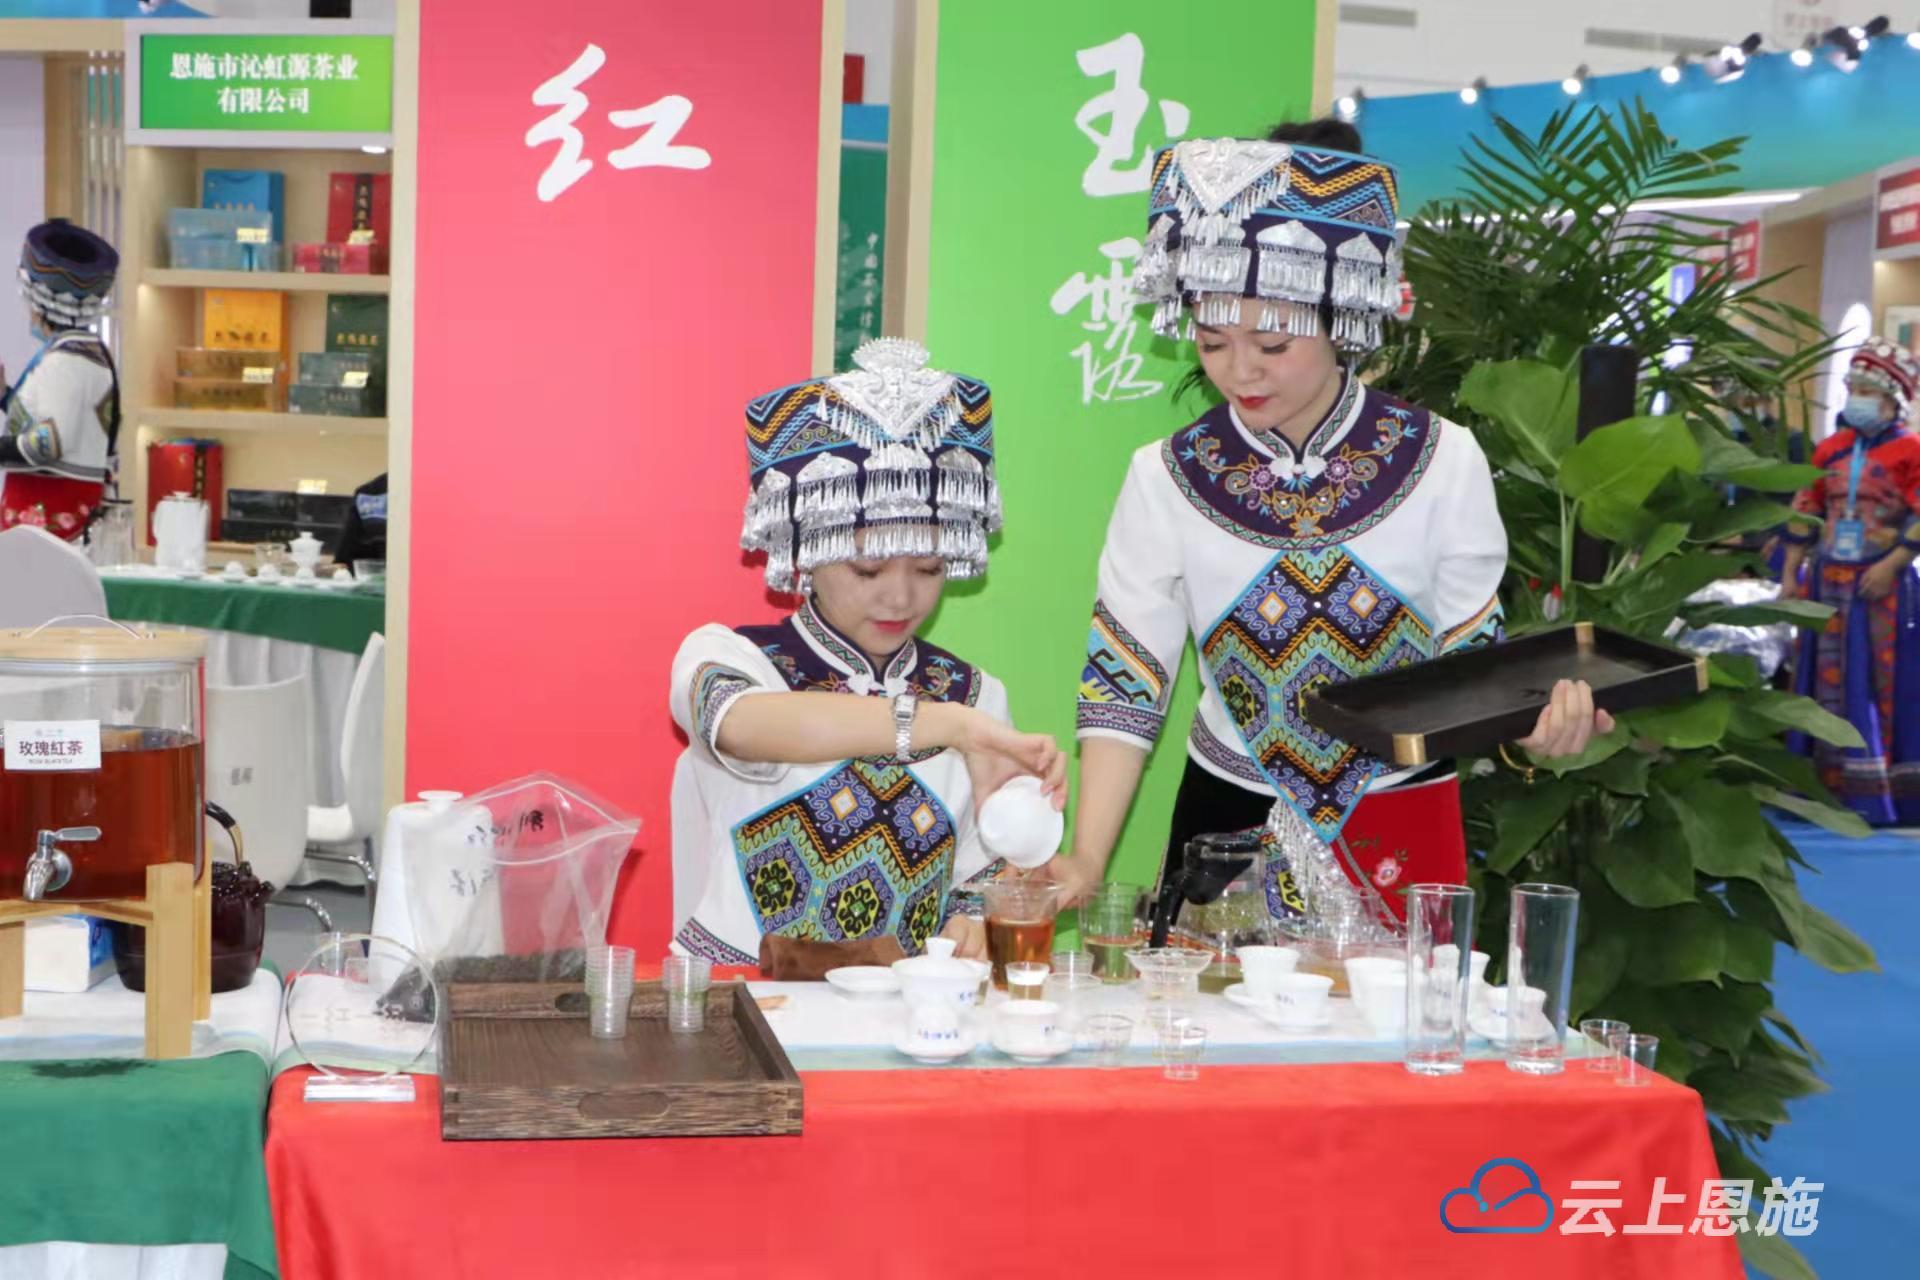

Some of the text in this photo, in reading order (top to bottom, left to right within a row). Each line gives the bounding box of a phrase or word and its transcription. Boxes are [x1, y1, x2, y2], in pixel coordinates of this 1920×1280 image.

[170, 52, 359, 80] 恩施市沁虹源茶业
[218, 87, 310, 114] 有限公司
[525, 43, 711, 202] 红
[19, 741, 83, 756] 玫瑰紅茶
